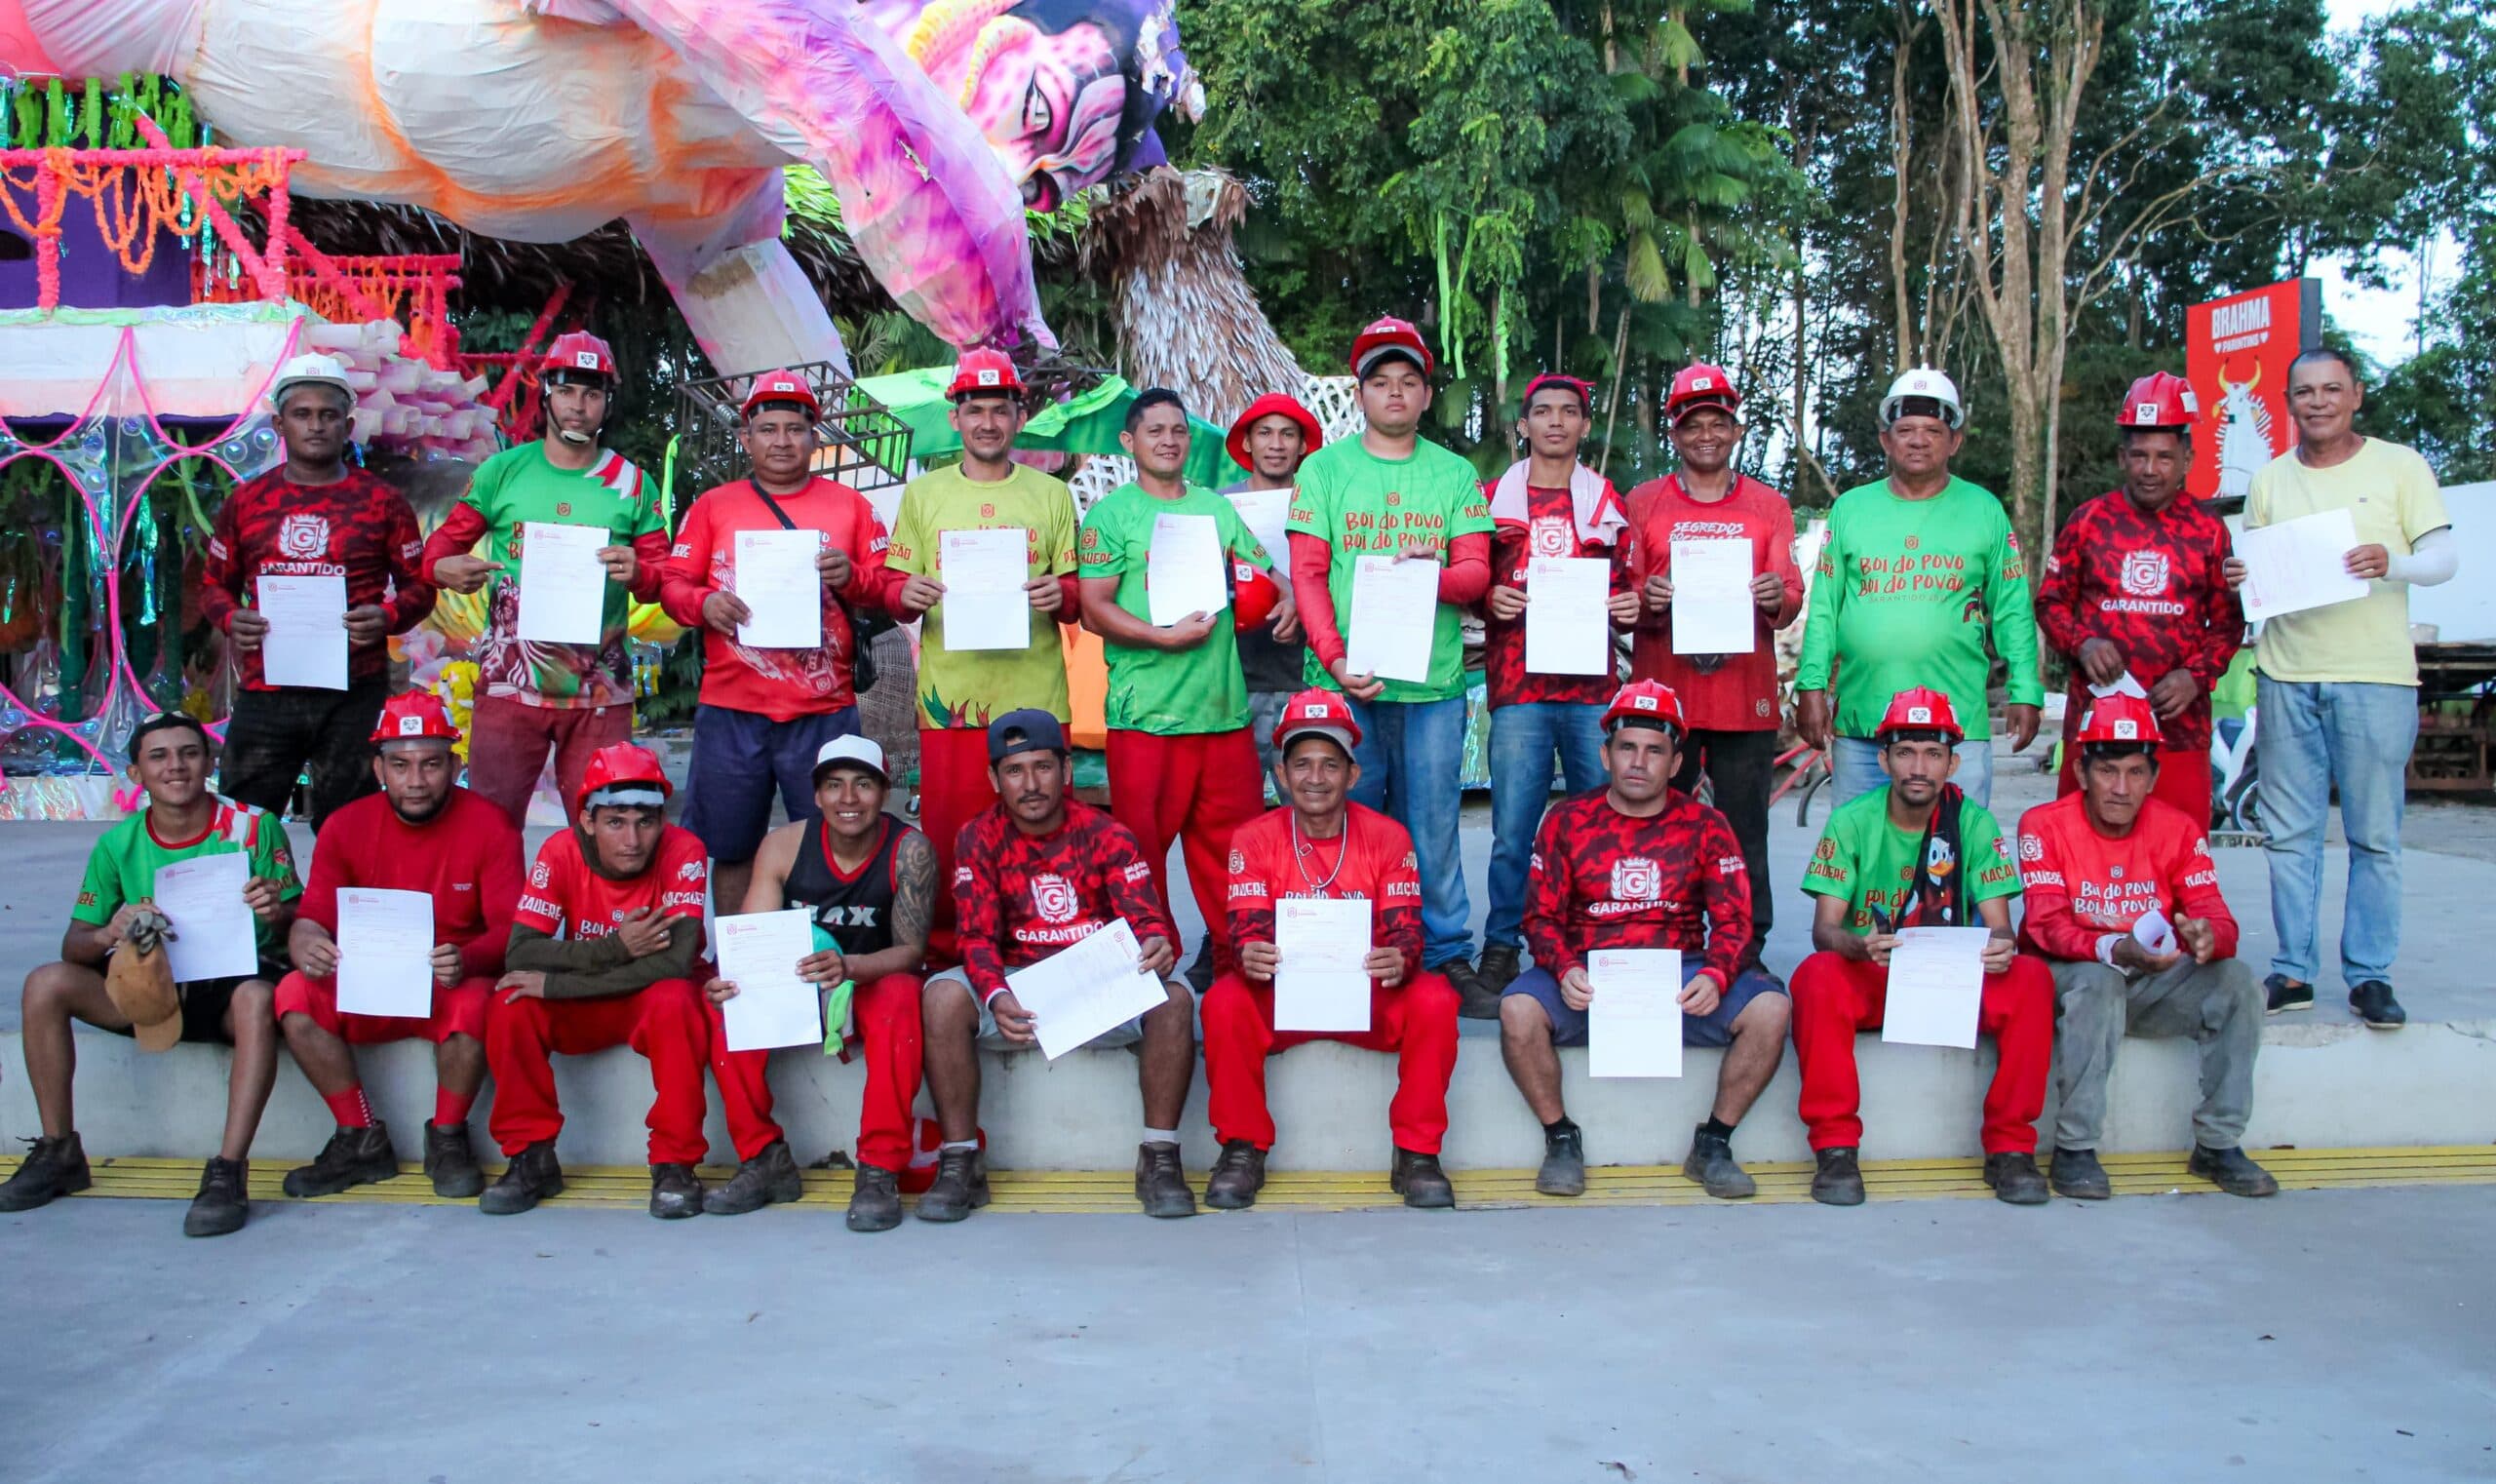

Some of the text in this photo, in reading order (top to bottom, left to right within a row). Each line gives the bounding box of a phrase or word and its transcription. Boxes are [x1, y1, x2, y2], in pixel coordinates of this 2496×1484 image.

[2211, 295, 2271, 340] BRAHMA
[1670, 521, 1744, 535] SEGREDOS
[260, 563, 346, 576] GARANTIDO
[2101, 600, 2185, 615] GARANTIDO
[1016, 920, 1105, 944] GARANTIDO
